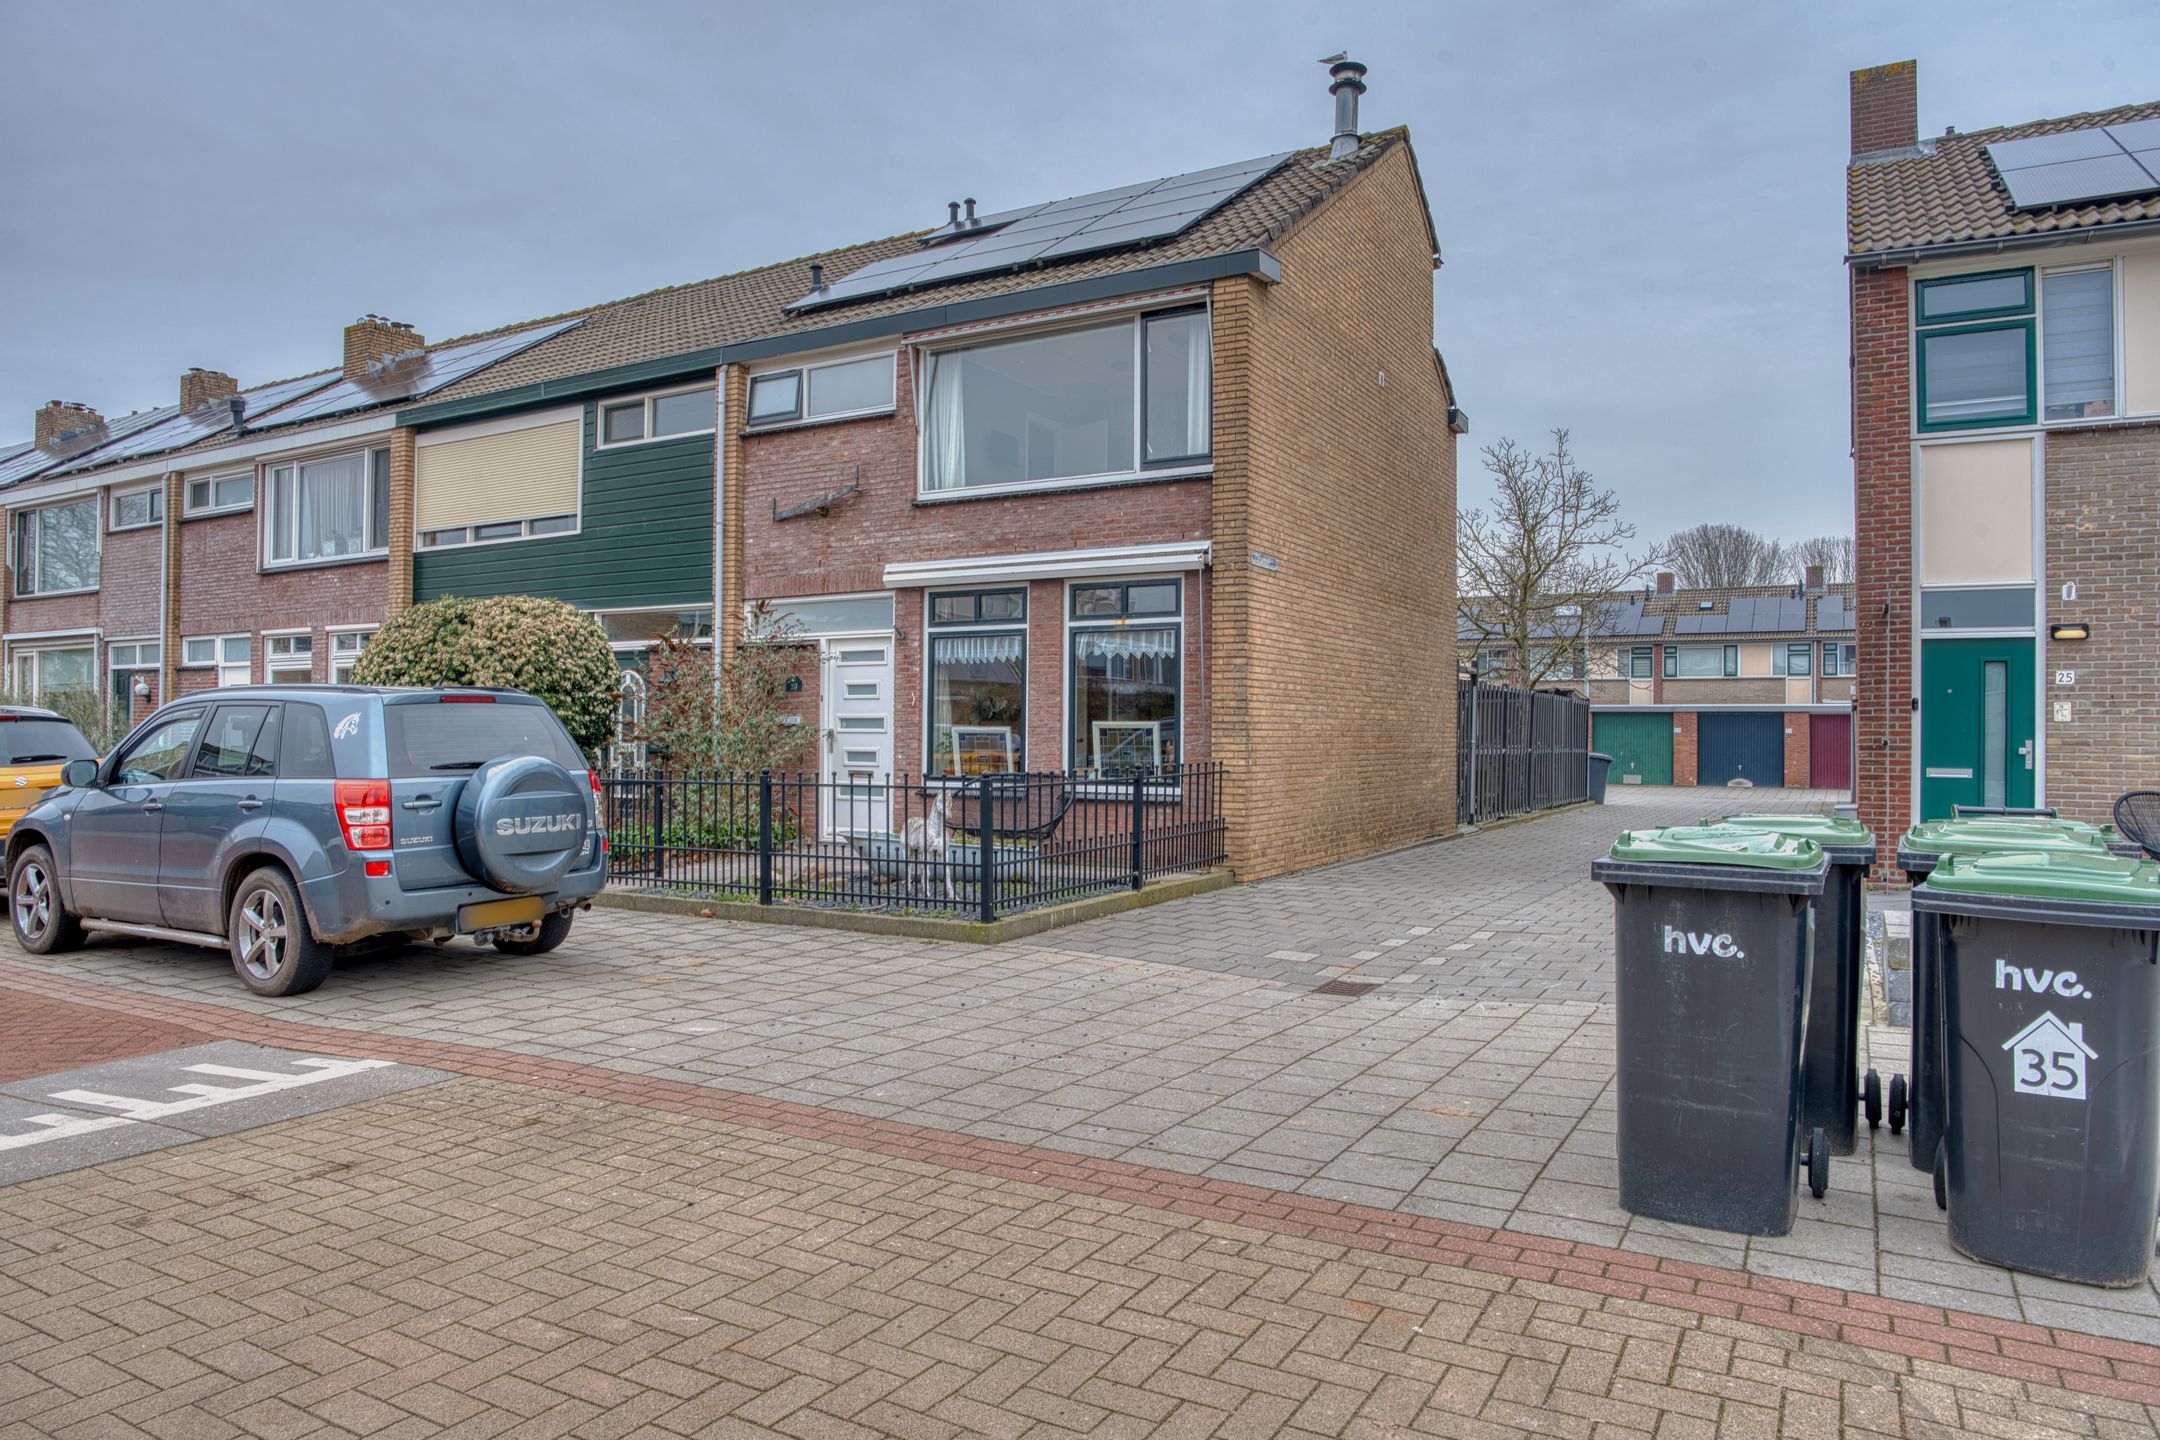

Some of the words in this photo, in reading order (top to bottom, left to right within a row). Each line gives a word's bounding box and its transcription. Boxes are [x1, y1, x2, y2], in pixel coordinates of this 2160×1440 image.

[2057, 672, 2073, 683] 25
[496, 813, 582, 836] SUZUKI
[400, 836, 433, 845] SUZUKI
[1664, 925, 1745, 959] hvc.
[1995, 959, 2093, 999] hvc.
[2020, 1048, 2079, 1091] 35
